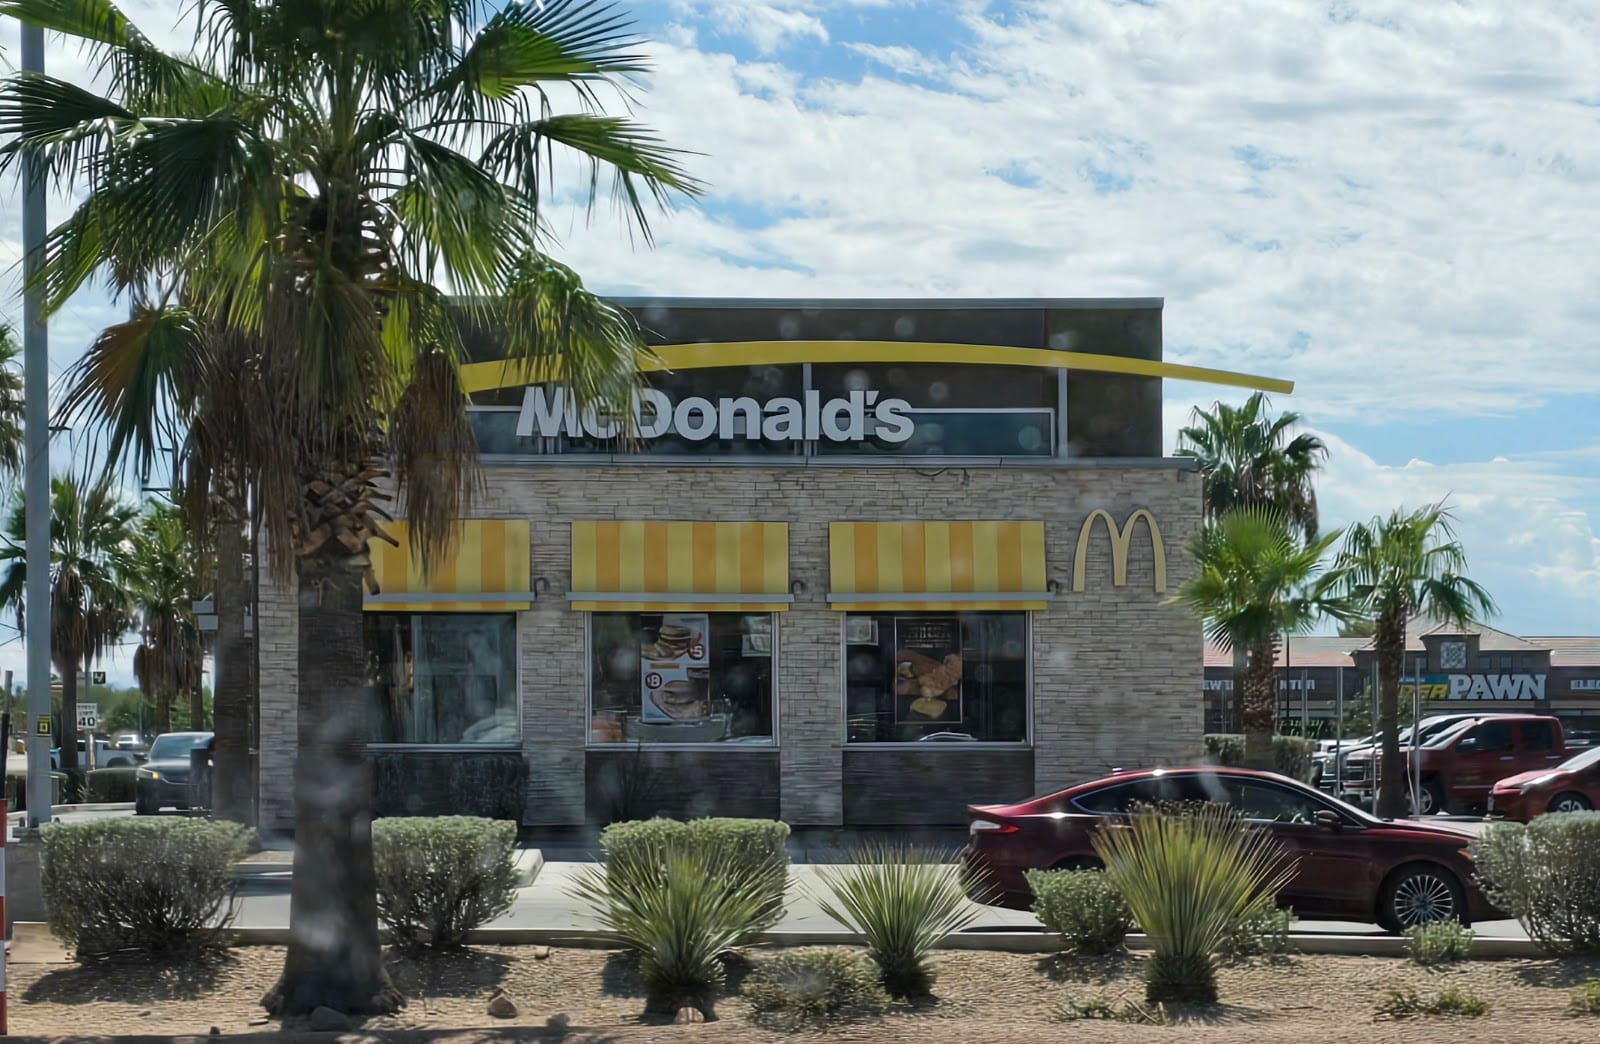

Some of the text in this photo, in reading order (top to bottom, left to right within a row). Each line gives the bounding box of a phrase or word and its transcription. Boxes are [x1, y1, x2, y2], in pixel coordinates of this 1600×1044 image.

[516, 386, 915, 442] McDonald's
[1447, 674, 1547, 700] PAWN
[78, 717, 95, 726] 40
